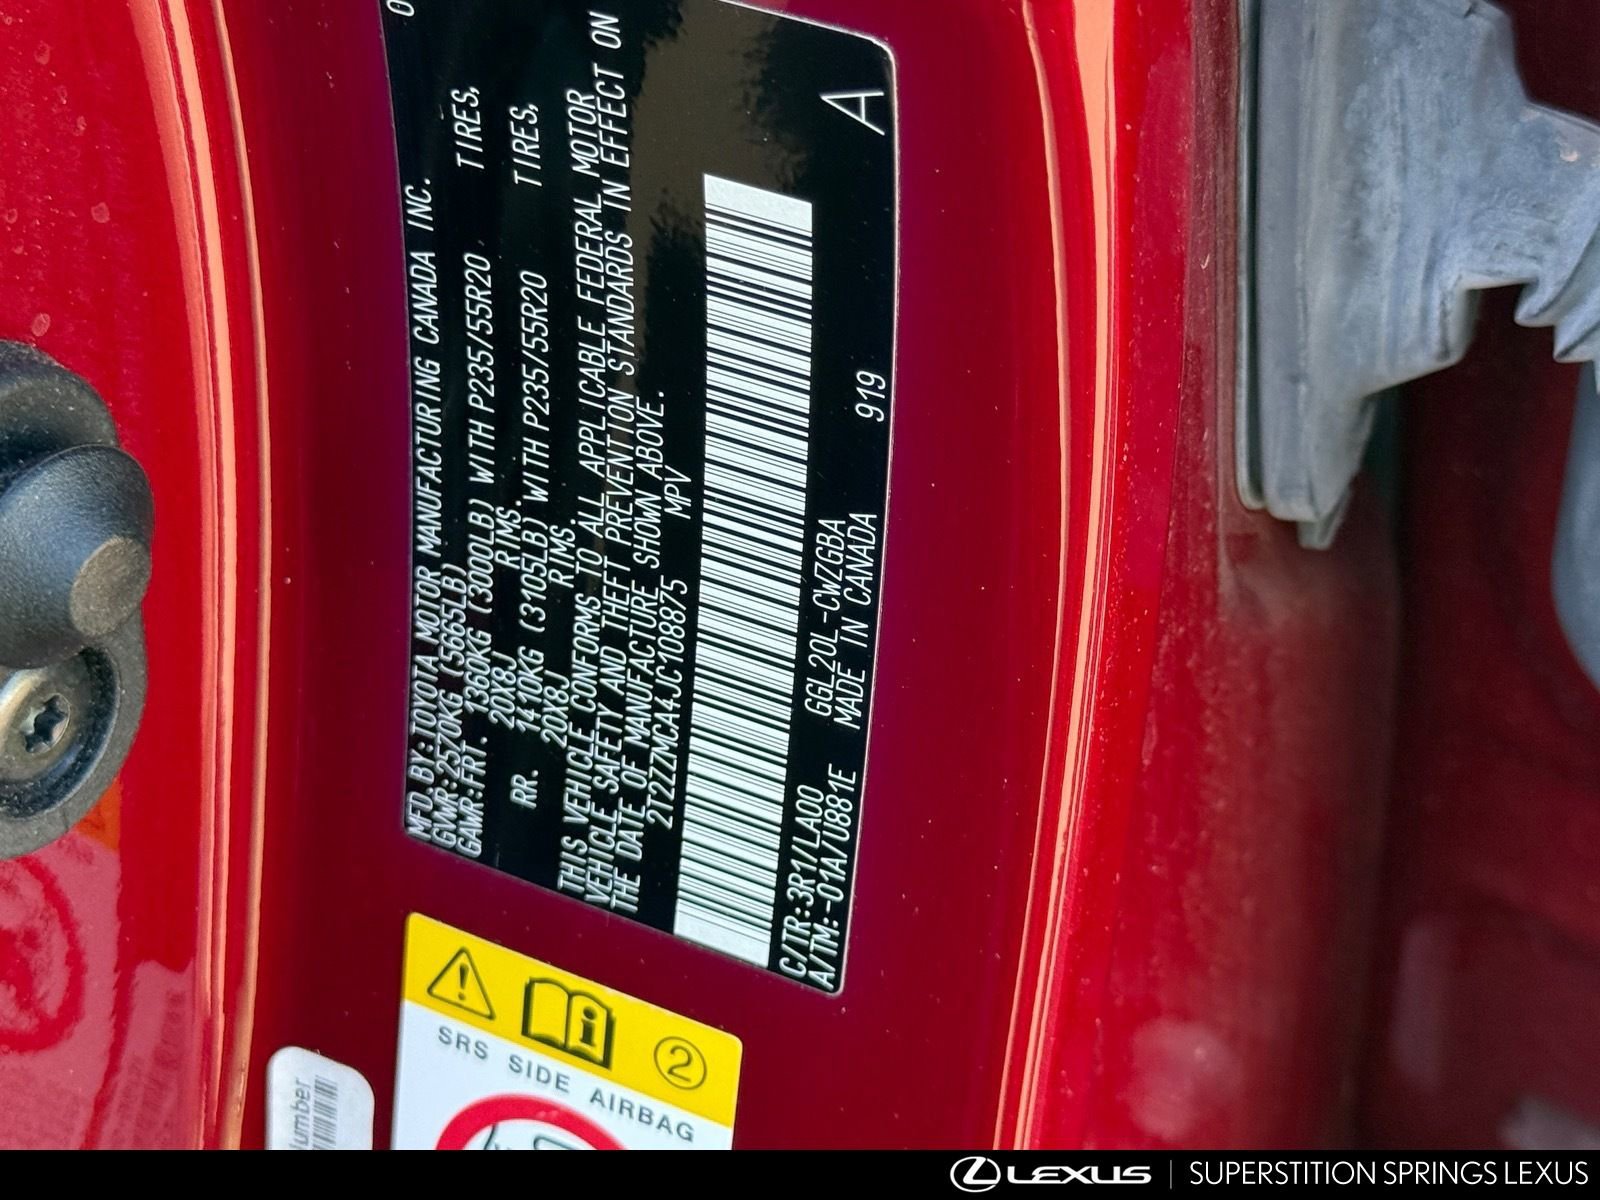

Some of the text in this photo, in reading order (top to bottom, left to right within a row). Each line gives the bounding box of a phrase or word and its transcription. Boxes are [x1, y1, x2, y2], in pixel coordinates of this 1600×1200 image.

[451, 86, 484, 170] TIRES,
[820, 89, 885, 136] A
[404, 177, 434, 231] INC.
[409, 251, 440, 345] CANADA
[463, 252, 495, 413] P235/55R20
[468, 419, 495, 483] WITH
[855, 370, 887, 422] 919
[413, 356, 442, 557] MANUFACTURING
[509, 104, 549, 809] RR. 1410KG (3105LB) WITH P235/55R20 TIRES,
[557, 89, 606, 893] THIS VEHICLE CONFORMS TO ALL APPLICABLE FEDERAL MOTOR
[584, 11, 635, 904] VEHICLE SAFETY AND THEFT PREVENTION STANDARDS IN EFFECT ON
[414, 565, 441, 645] MOTOR
[467, 499, 495, 614] (3000LB)
[843, 513, 877, 605] CANADA
[438, 563, 467, 677] (5665LB)
[463, 627, 492, 713] 1360KG
[488, 500, 521, 730] 20X8J RIMS.
[540, 519, 576, 749] 20X8J RIMS.
[610, 391, 664, 913] THE DATE OF MANUFACTURE SHOWN ABOVE.
[645, 465, 692, 830] 2T2ZZMCA4JC108875 MPV
[840, 616, 868, 648] IN
[833, 662, 865, 730] MADE
[438, 1026, 696, 1143] SRS SIDE AIRBAG
